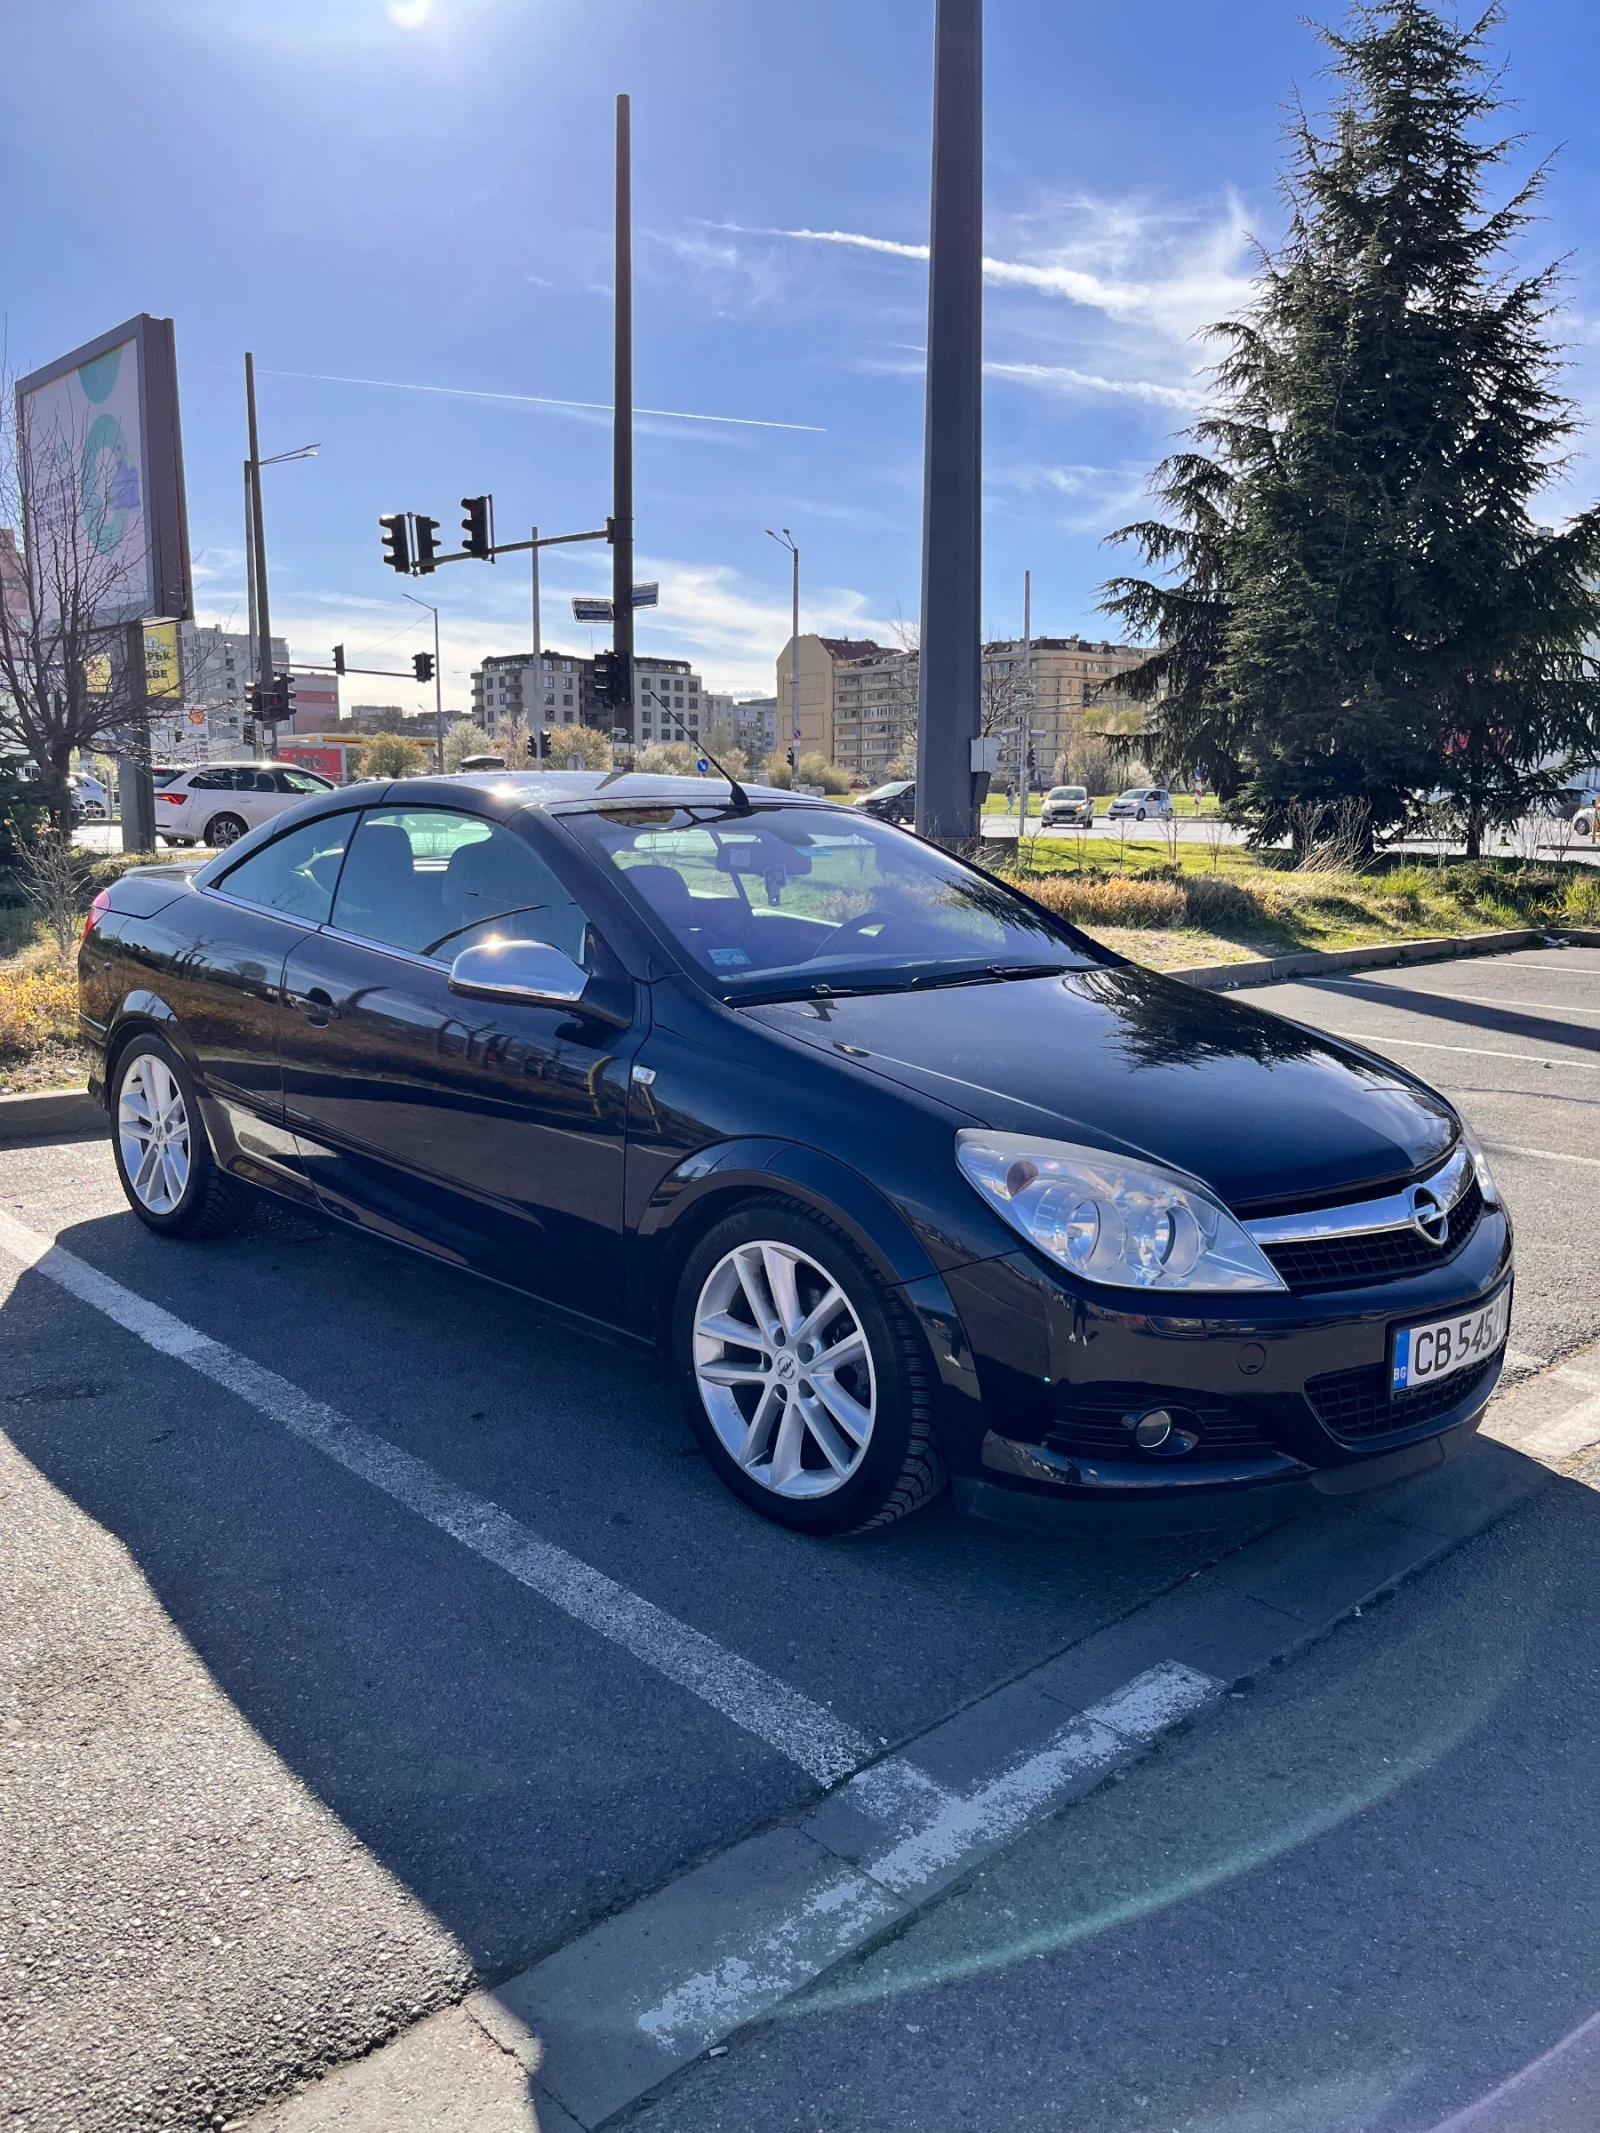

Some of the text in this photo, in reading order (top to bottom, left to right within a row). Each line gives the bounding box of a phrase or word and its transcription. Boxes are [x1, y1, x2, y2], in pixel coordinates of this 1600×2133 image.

[145, 651, 170, 661] РЪК
[1415, 1327, 1451, 1376] CB
[1393, 1366, 1407, 1381] BG
